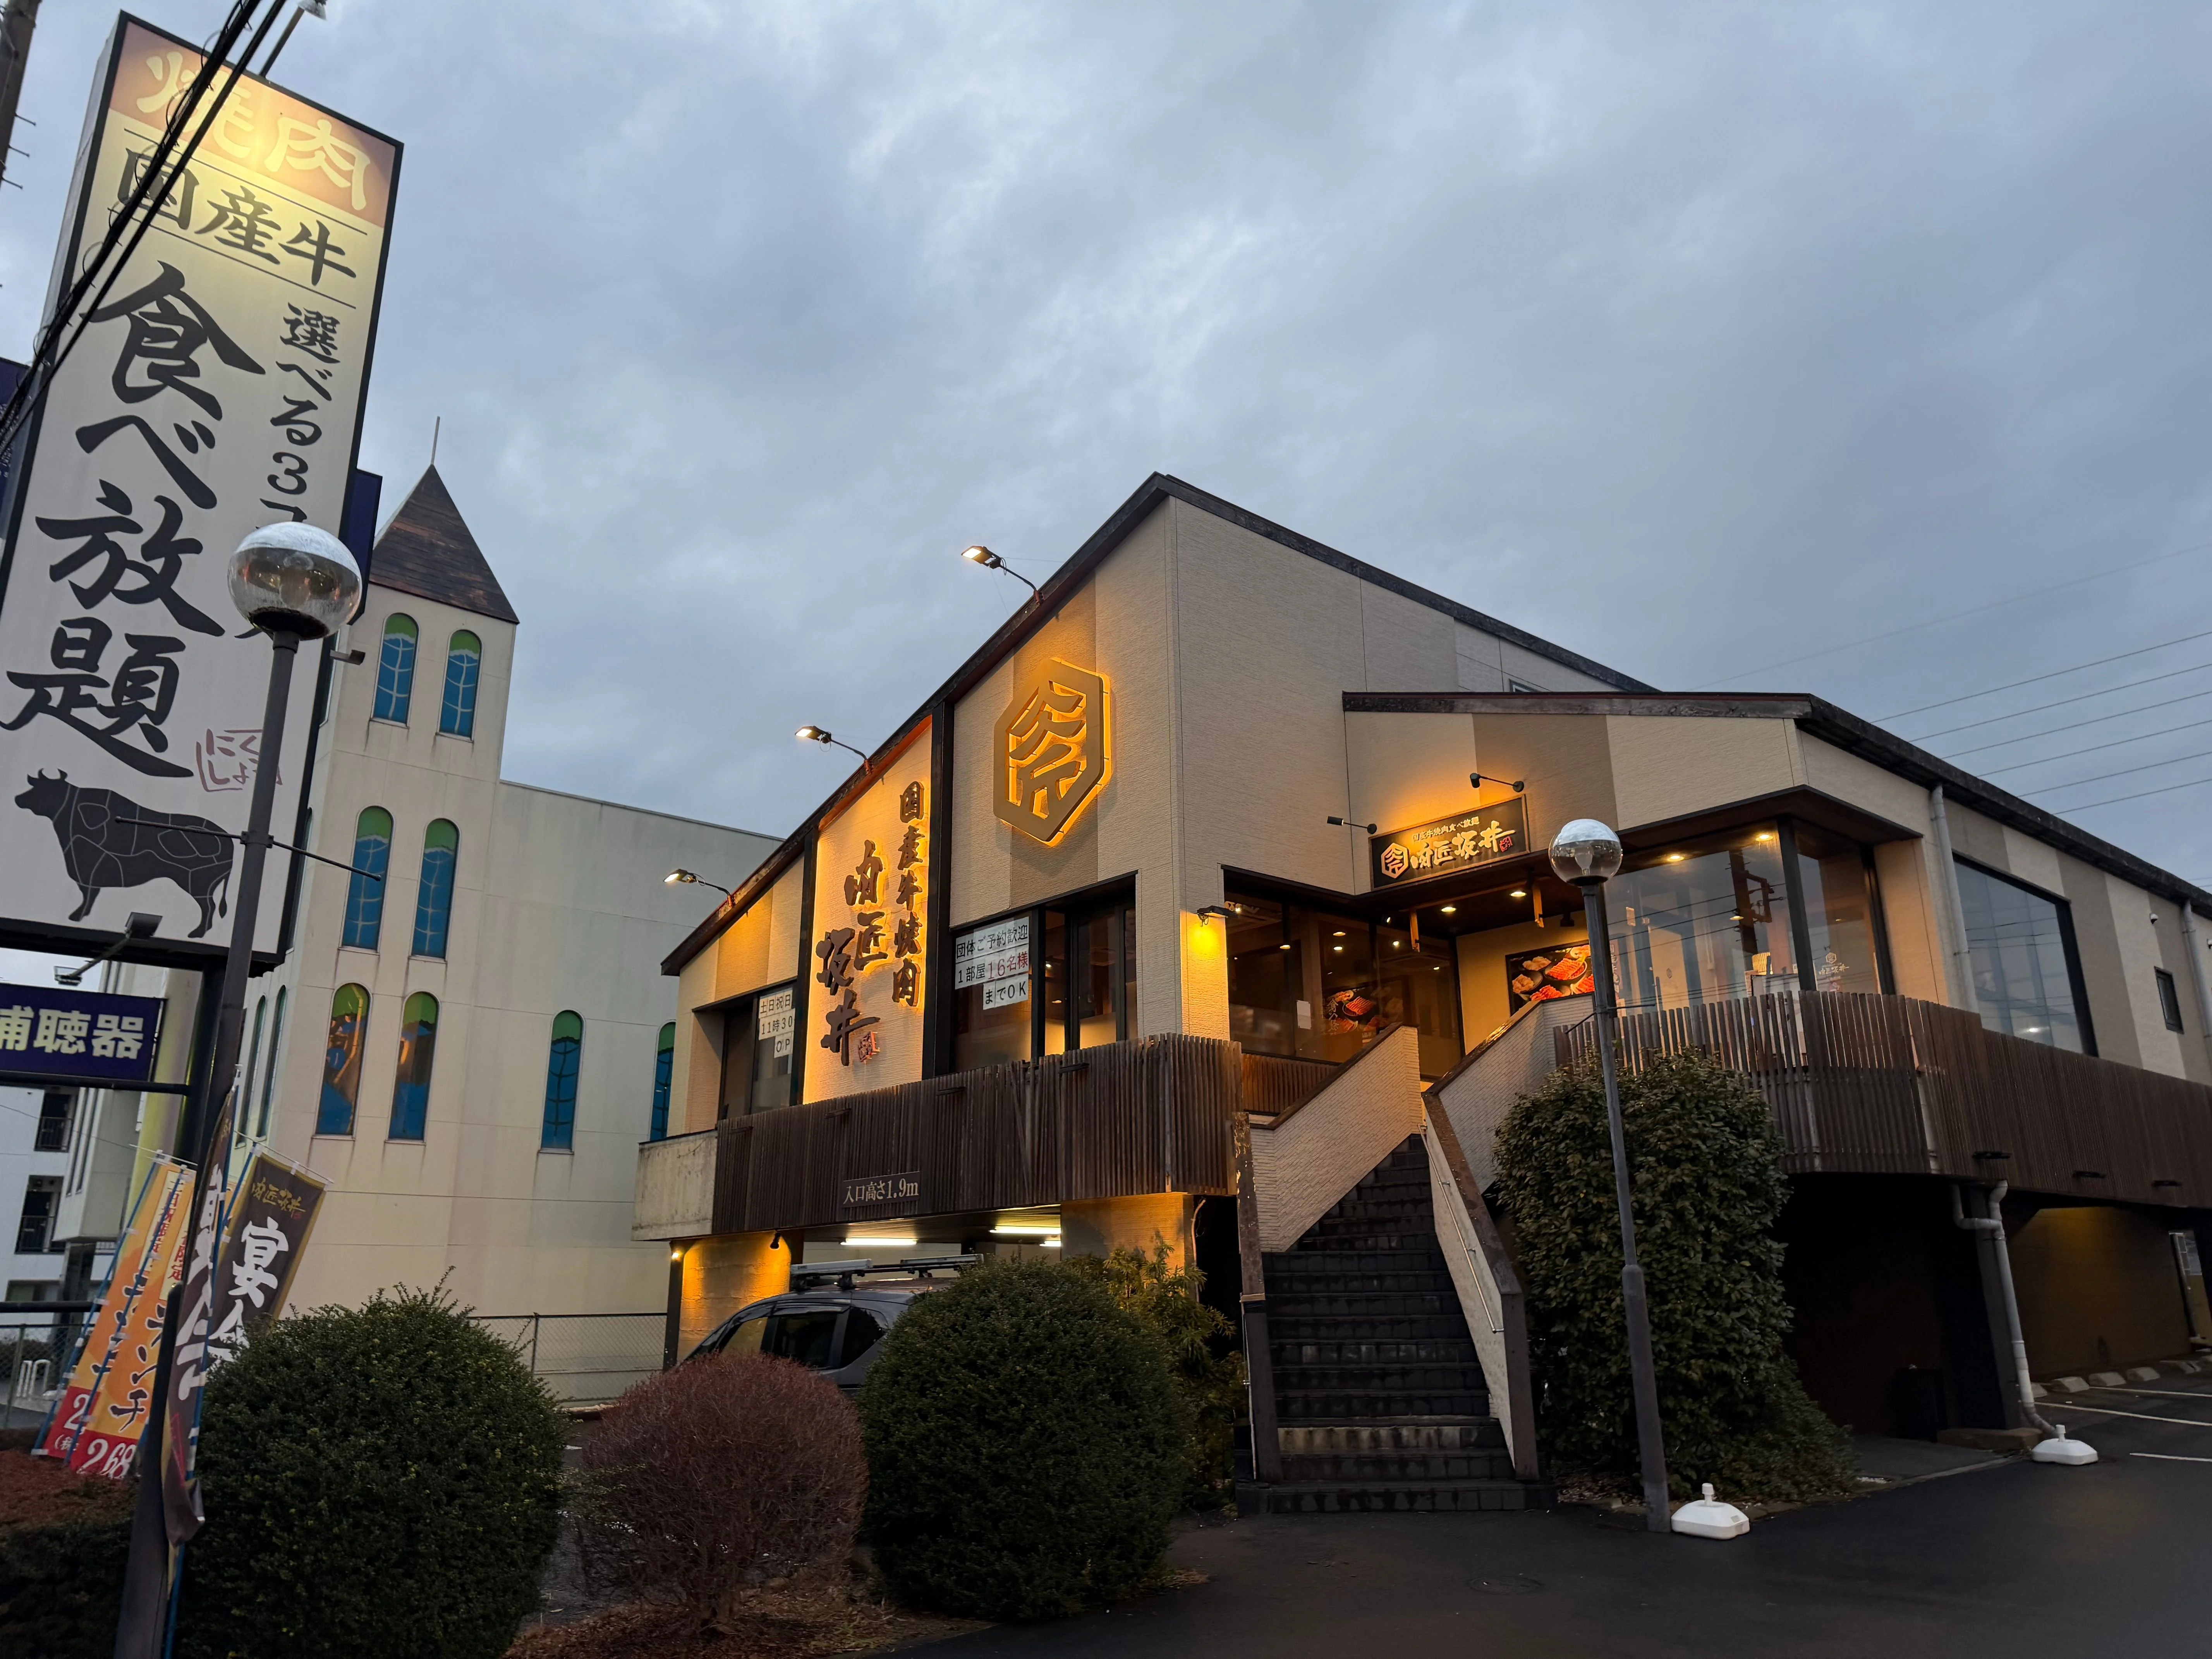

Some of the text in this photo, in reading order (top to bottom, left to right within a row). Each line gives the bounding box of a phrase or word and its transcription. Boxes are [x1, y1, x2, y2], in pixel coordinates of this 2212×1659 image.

[116, 148, 357, 287] 国産牛
[0, 260, 266, 778] 食べ放題
[1410, 820, 1516, 869] 肉匠坂井
[892, 781, 925, 1007] 国産牛焼肉
[956, 924, 1028, 959] 団体ご予約歓迎
[760, 994, 791, 1014] 土日祝日
[843, 1178, 919, 1205] 入口高さ1.9m
